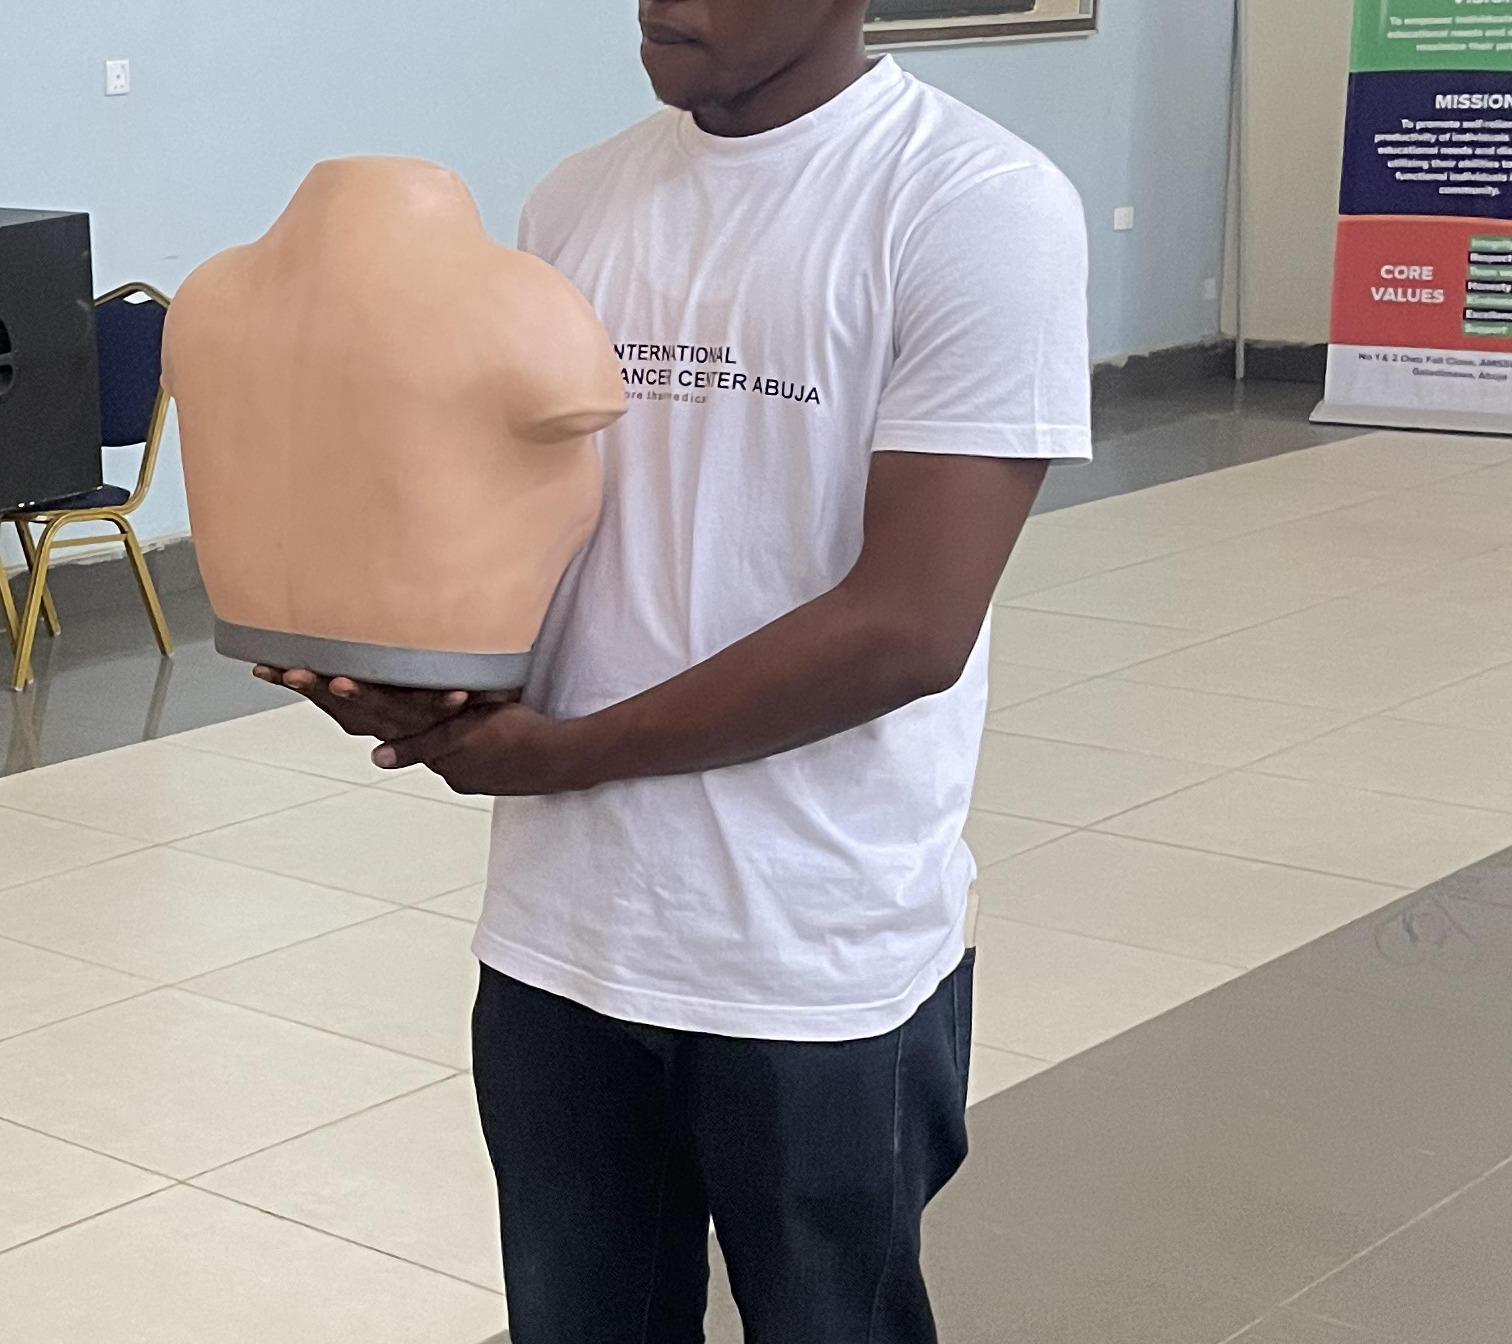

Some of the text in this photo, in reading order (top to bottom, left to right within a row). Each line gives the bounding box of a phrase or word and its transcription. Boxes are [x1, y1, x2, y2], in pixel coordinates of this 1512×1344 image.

[1380, 264, 1433, 281] CORE
[1370, 286, 1445, 304] VALUES
[614, 343, 736, 364] NTERNATIONAL
[752, 376, 820, 405] ABUJA
